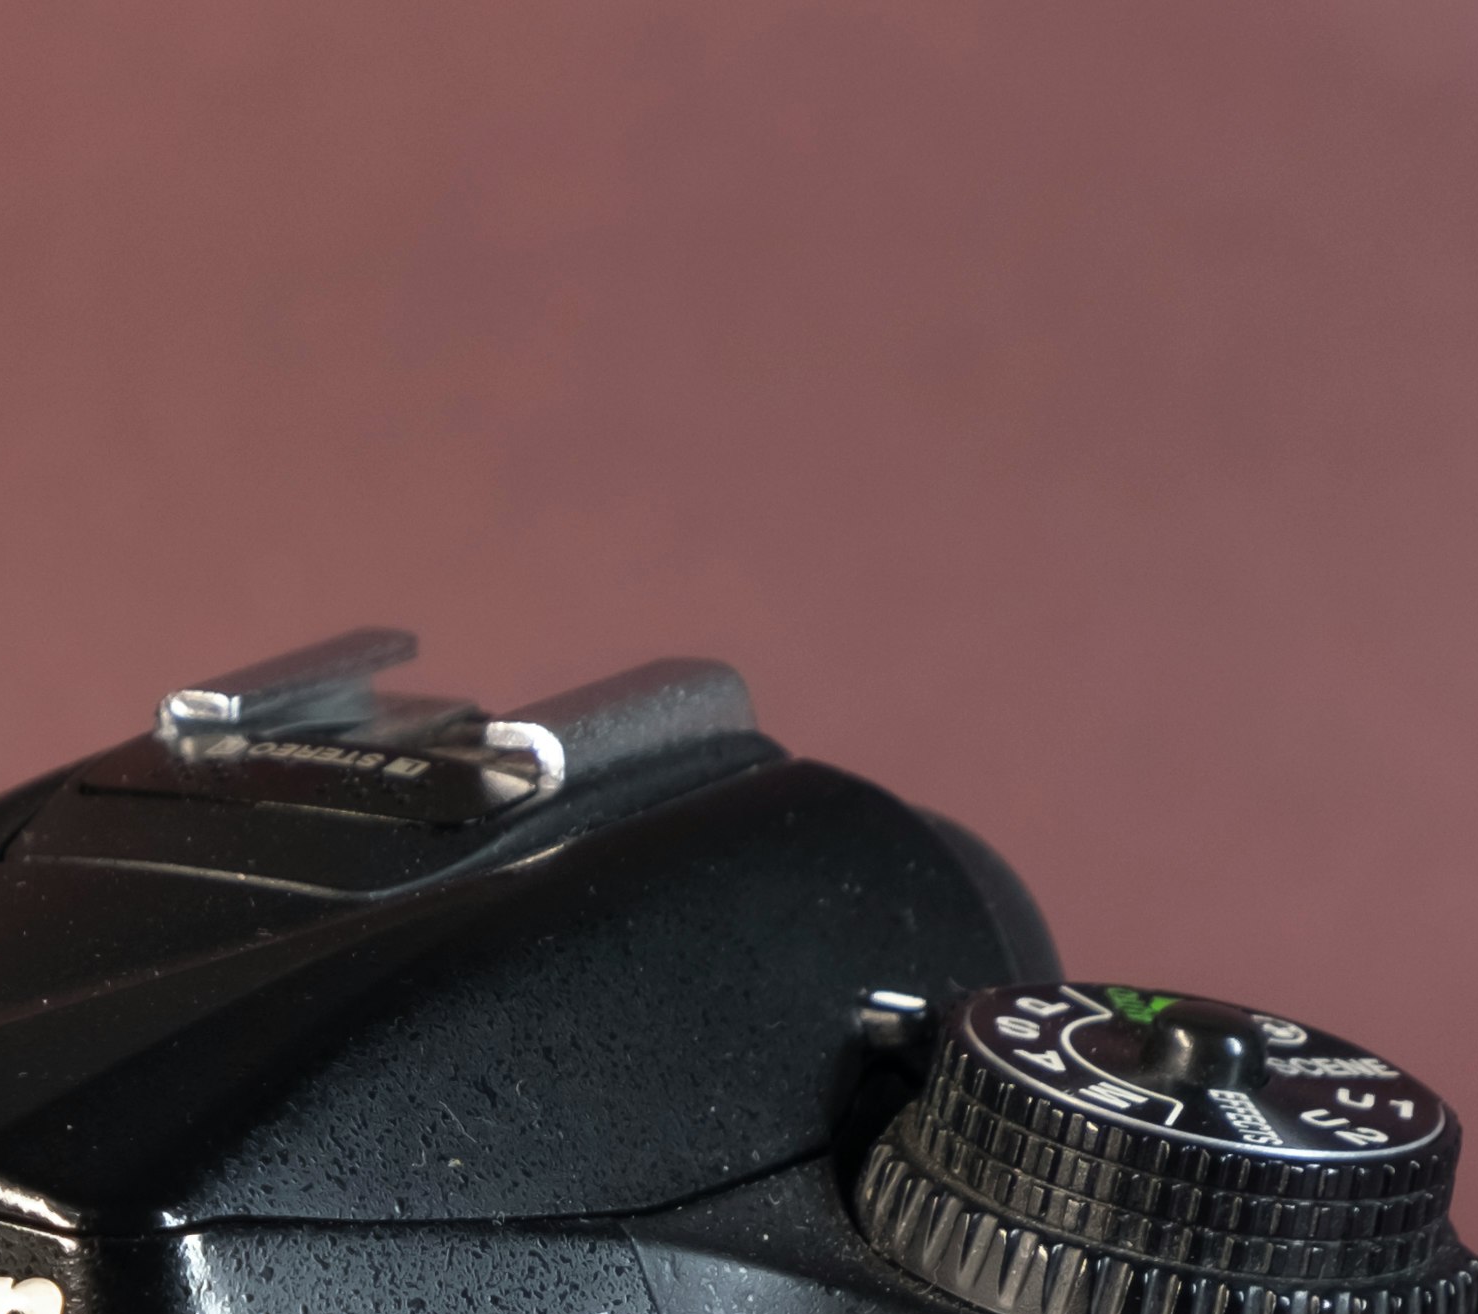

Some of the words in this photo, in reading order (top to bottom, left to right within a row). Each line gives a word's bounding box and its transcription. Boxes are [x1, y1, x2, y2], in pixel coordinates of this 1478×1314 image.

[248, 741, 386, 769] STEREO
[1013, 1050, 1067, 1073] A
[1265, 1057, 1400, 1078] SCENE
[1078, 1081, 1149, 1110] M
[1207, 1088, 1284, 1146] EFFECTS
